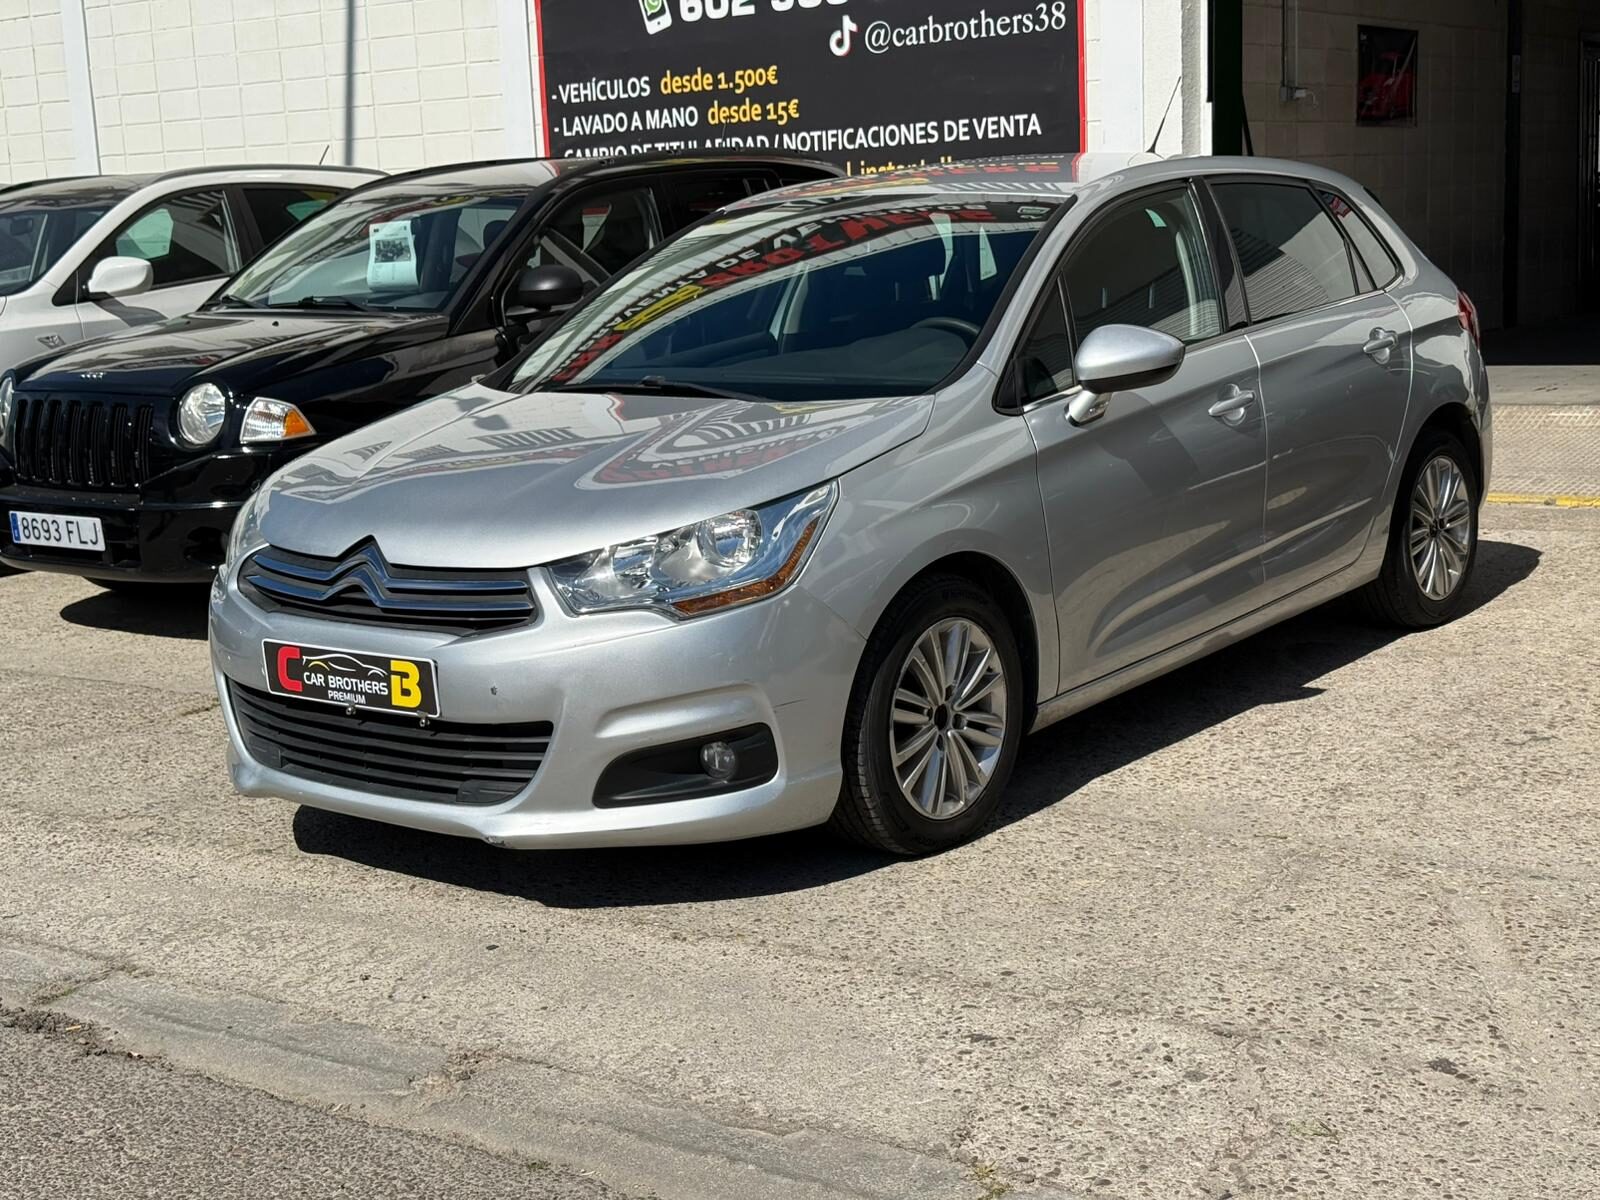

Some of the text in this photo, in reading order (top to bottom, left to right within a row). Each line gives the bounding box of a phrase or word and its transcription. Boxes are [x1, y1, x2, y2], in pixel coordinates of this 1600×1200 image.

[865, 1, 1066, 53] @carbrothers38
[660, 66, 713, 94] desde
[717, 65, 778, 94] 1.500€
[630, 111, 643, 131] A
[645, 106, 698, 130] MANO
[707, 97, 762, 125] desde
[766, 98, 799, 125] 15€
[783, 121, 939, 152] NOTIFICACIONES
[943, 118, 969, 142] DE
[972, 113, 1042, 140] VENTA
[21, 517, 99, 545] 8693 FLJ
[303, 671, 389, 695] CAR BROTHERS
[327, 690, 366, 704] PREMIUM
